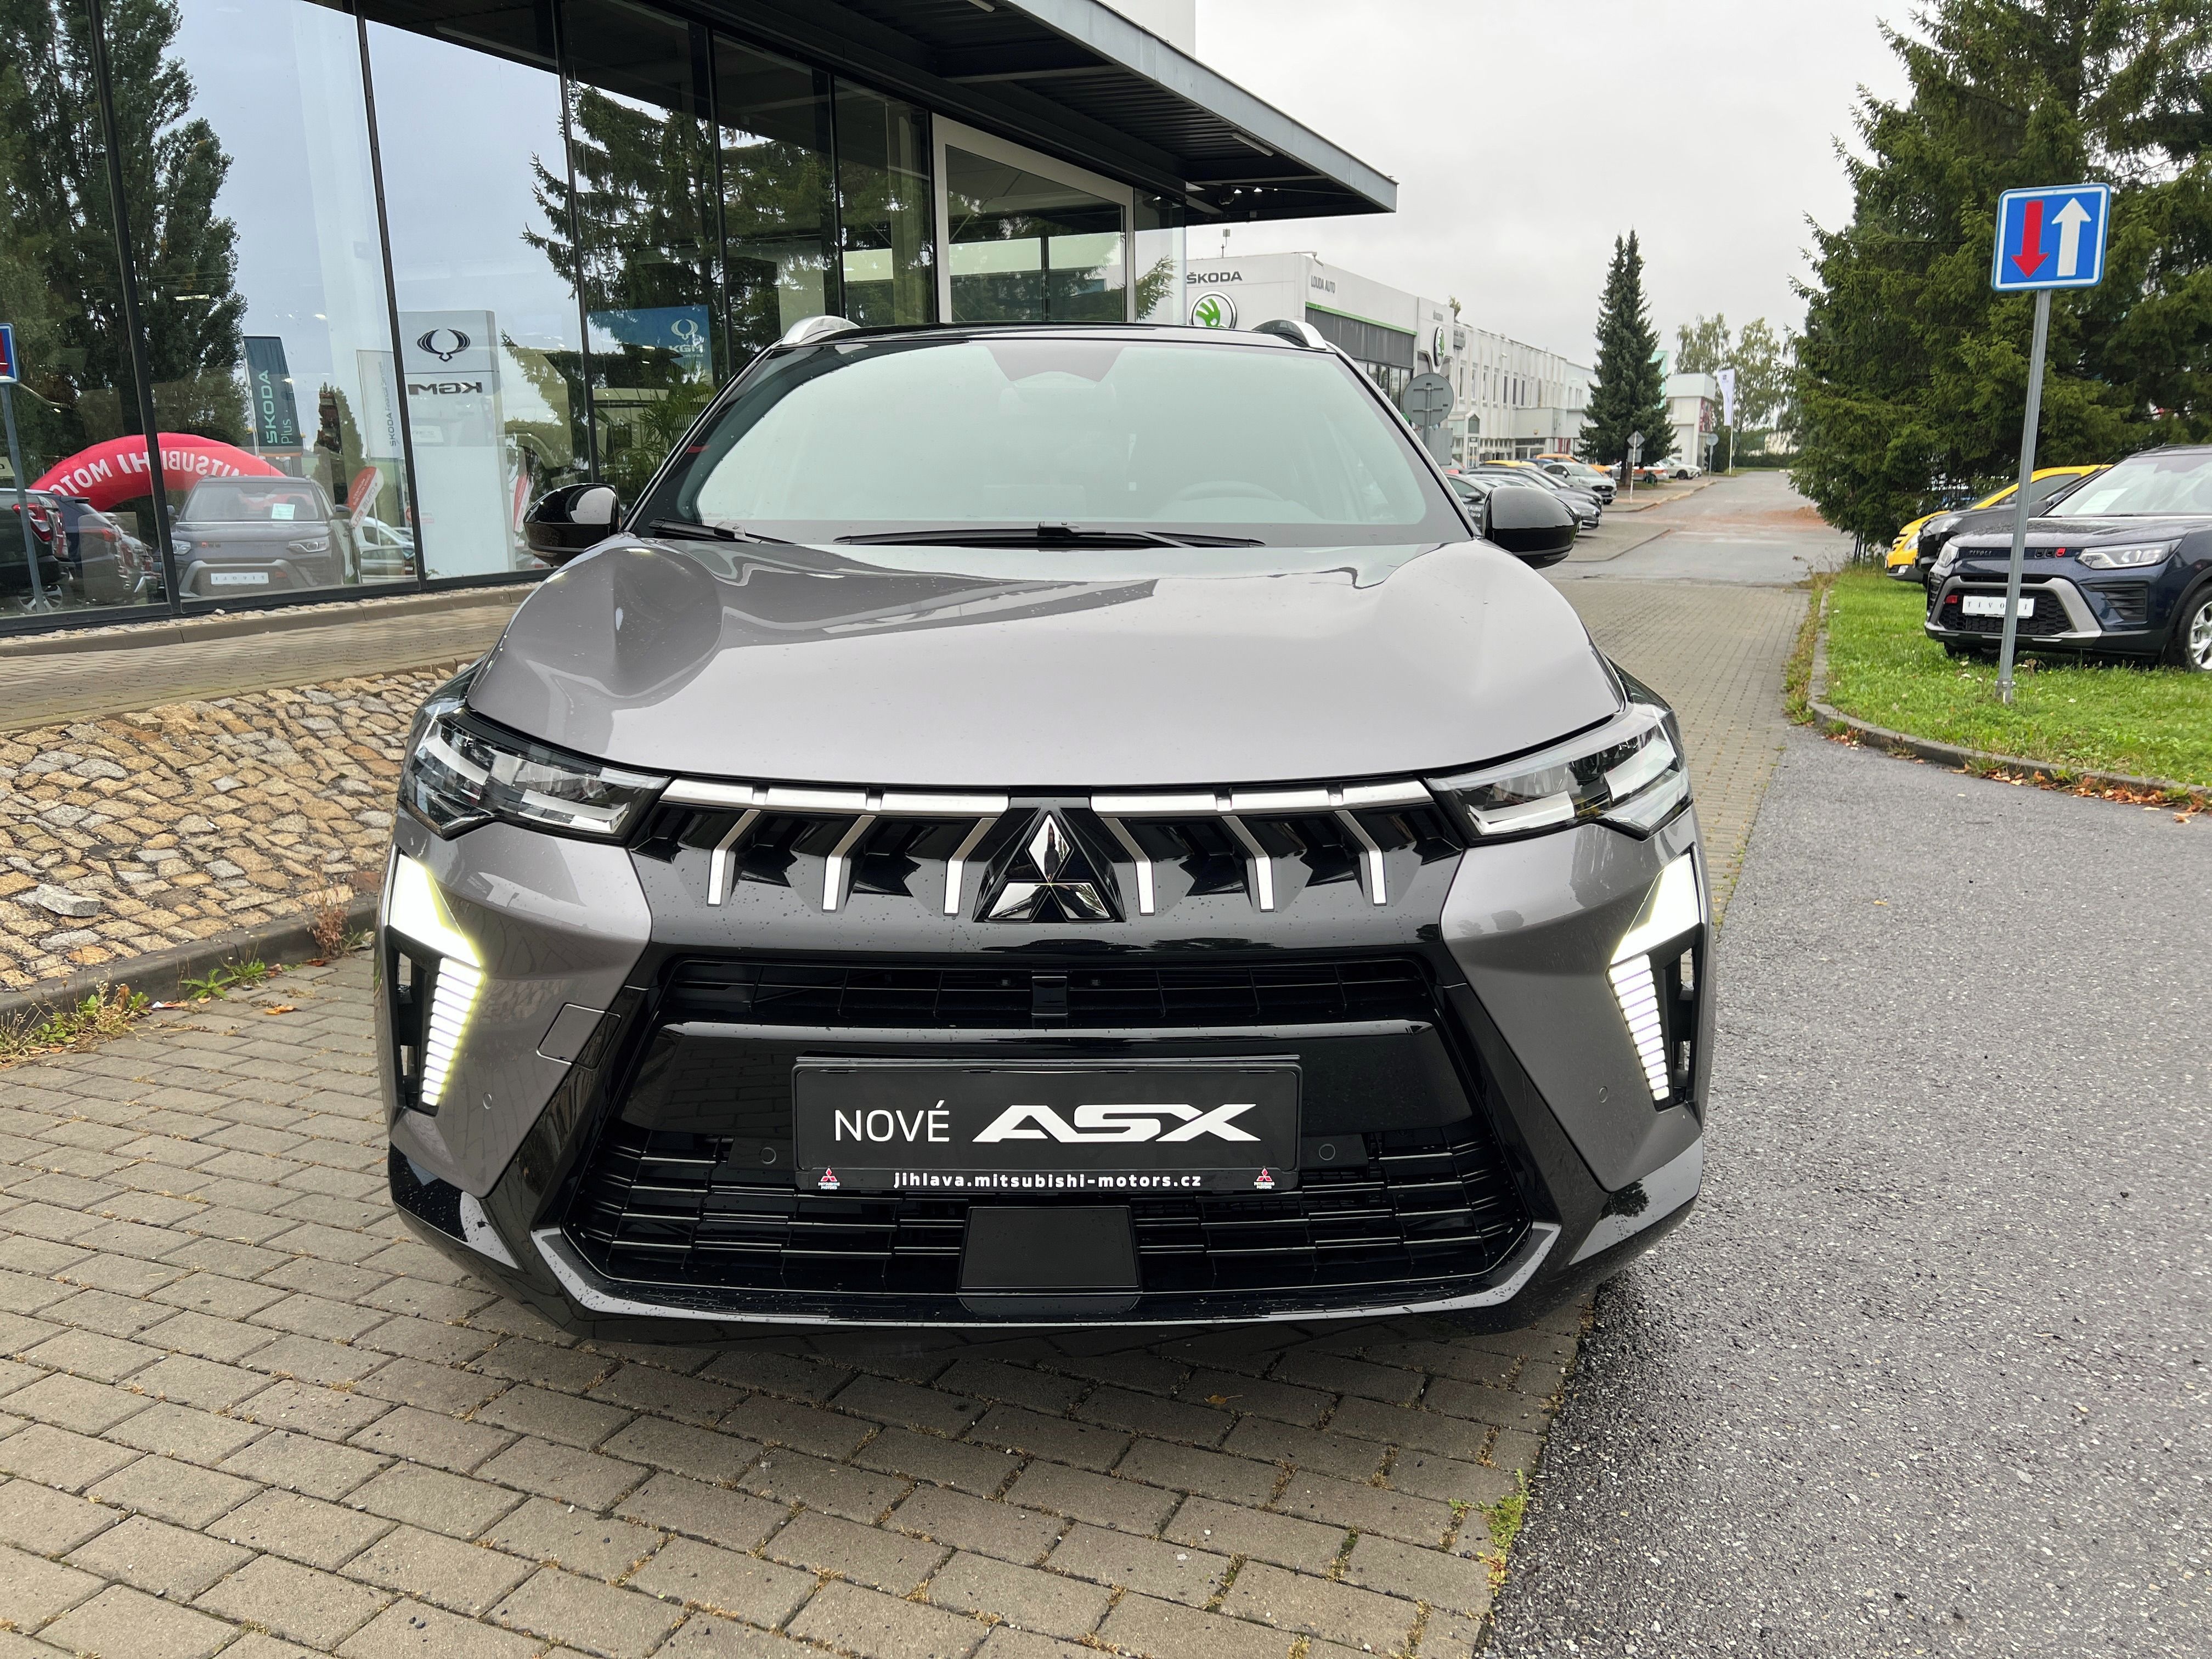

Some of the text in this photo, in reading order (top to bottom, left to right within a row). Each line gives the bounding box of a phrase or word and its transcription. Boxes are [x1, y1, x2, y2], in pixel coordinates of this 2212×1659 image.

[1187, 271, 1243, 284] ŠKODA
[669, 344, 703, 353] KGM
[1967, 601, 2027, 610] TIVOI
[835, 1100, 1261, 1143] NOVÉ ASX
[893, 1172, 1201, 1188] jihlava.mitsubishi-motors.cz
